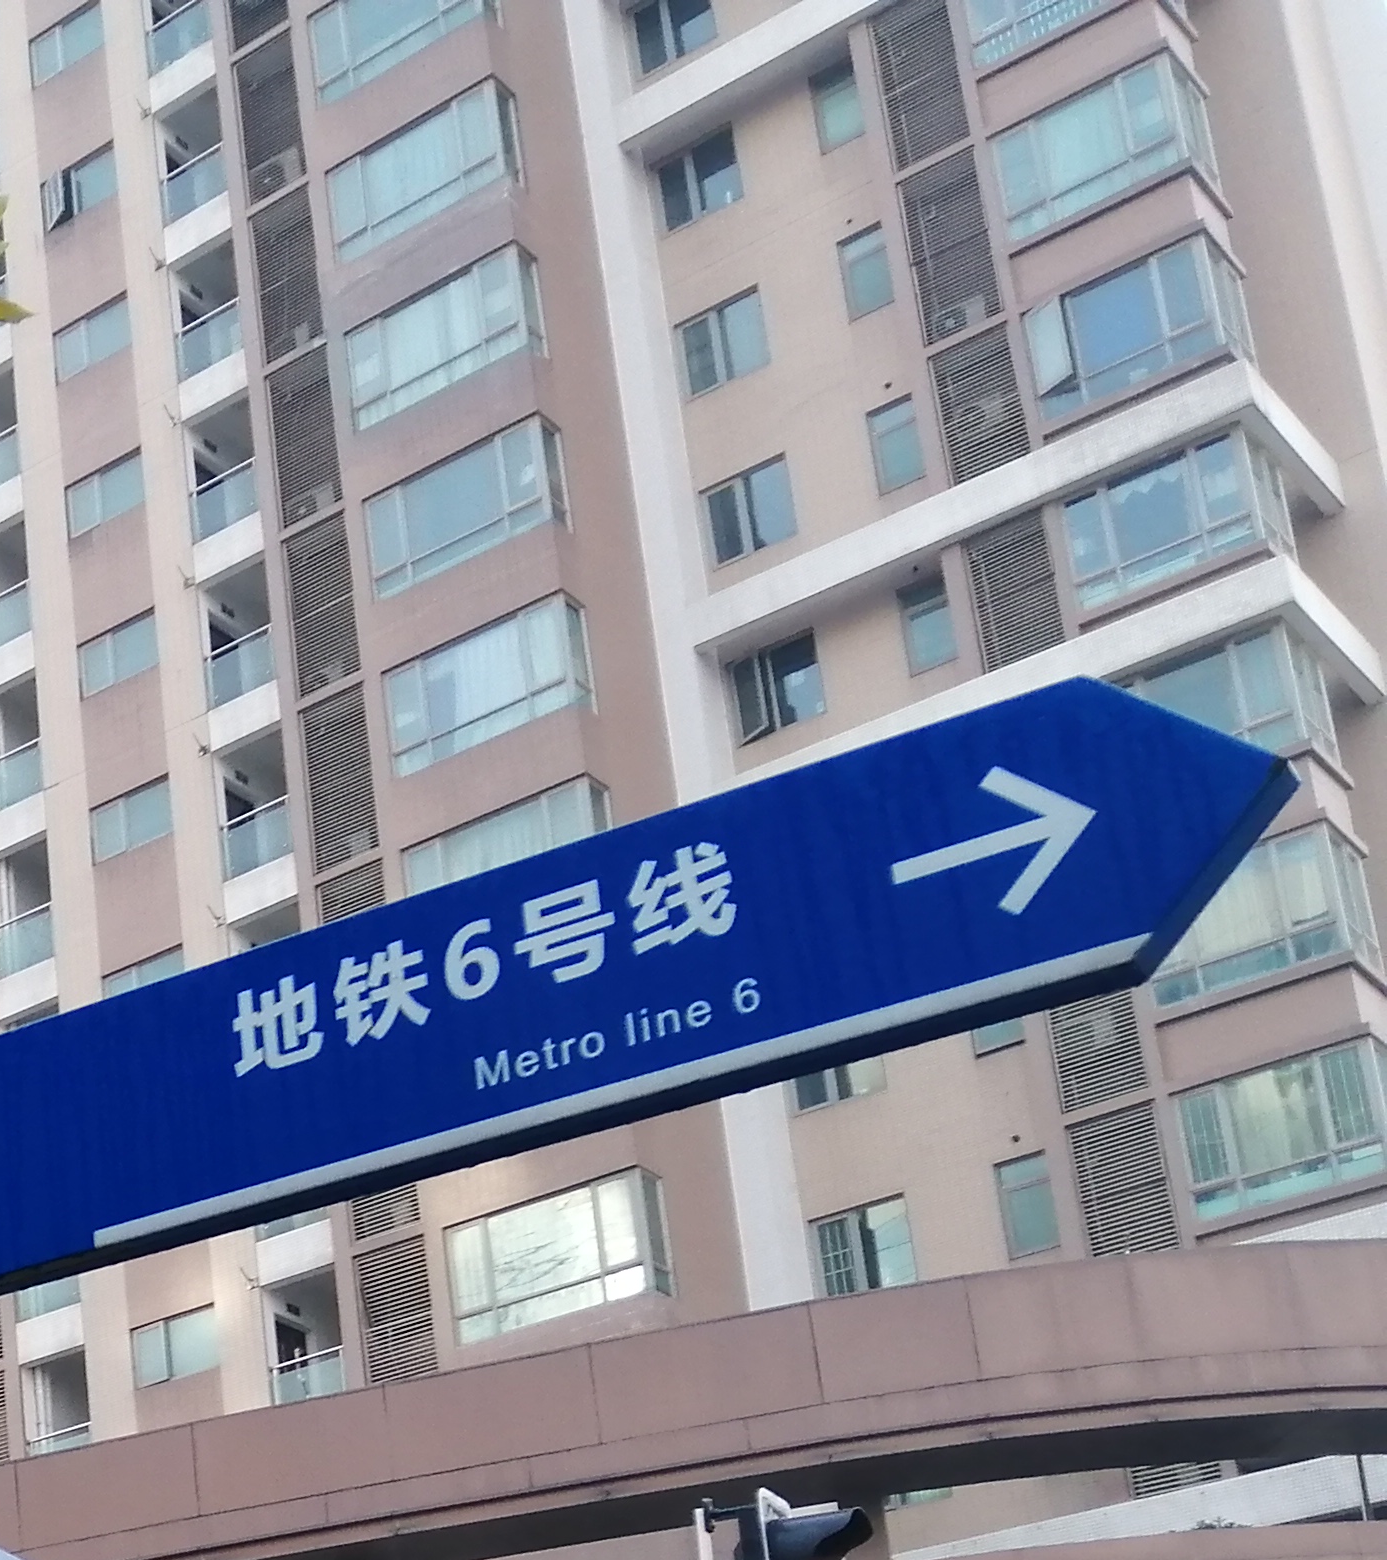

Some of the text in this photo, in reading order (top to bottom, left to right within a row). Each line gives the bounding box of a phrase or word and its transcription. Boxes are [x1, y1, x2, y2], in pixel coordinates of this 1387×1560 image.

[232, 842, 737, 1078] 地铁6号线
[473, 977, 761, 1089] Metro line 6
